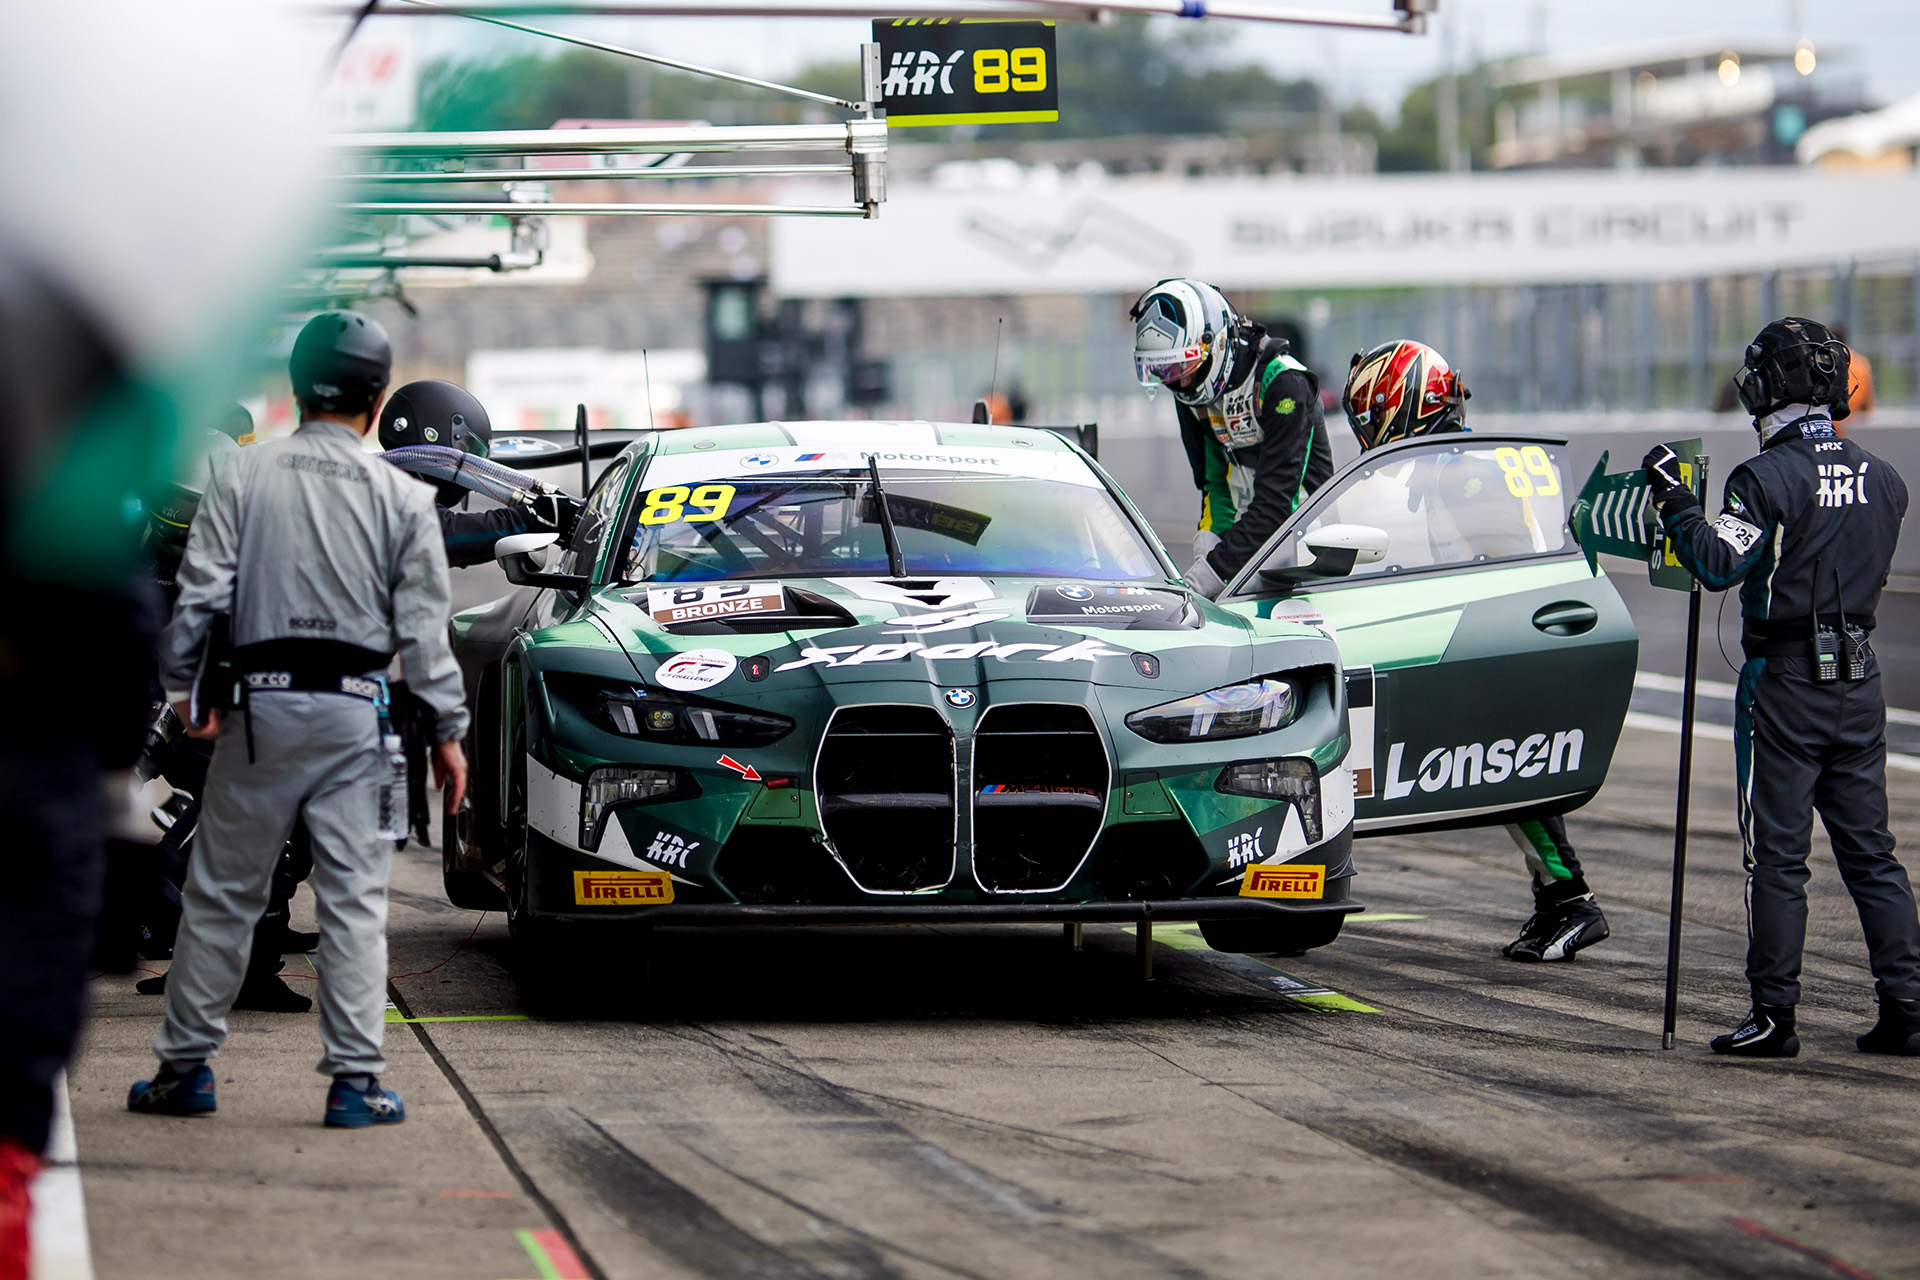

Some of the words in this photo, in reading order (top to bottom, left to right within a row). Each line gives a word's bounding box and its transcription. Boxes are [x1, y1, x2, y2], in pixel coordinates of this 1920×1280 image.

[882, 50, 964, 96] KRC
[973, 47, 1047, 93] 89
[1227, 208, 1513, 252] SUZUKA
[1533, 201, 1804, 248] CIRCUIT
[859, 451, 1000, 466] Motorsport
[1814, 442, 1843, 452] HRX
[1495, 446, 1560, 497] 89
[1816, 461, 1869, 507] KRC
[638, 485, 736, 526] 89
[288, 617, 338, 632] sparco
[672, 598, 763, 620] BRONZE
[1081, 603, 1164, 615] Motorsport
[773, 638, 1129, 672] spark
[672, 674, 715, 683] CHALLENGE
[1384, 728, 1584, 800] Lonsen
[646, 831, 700, 868] KRC
[1227, 826, 1264, 869] KRC
[583, 878, 664, 898] PIRELLI
[1250, 871, 1319, 892] PIRELLI
